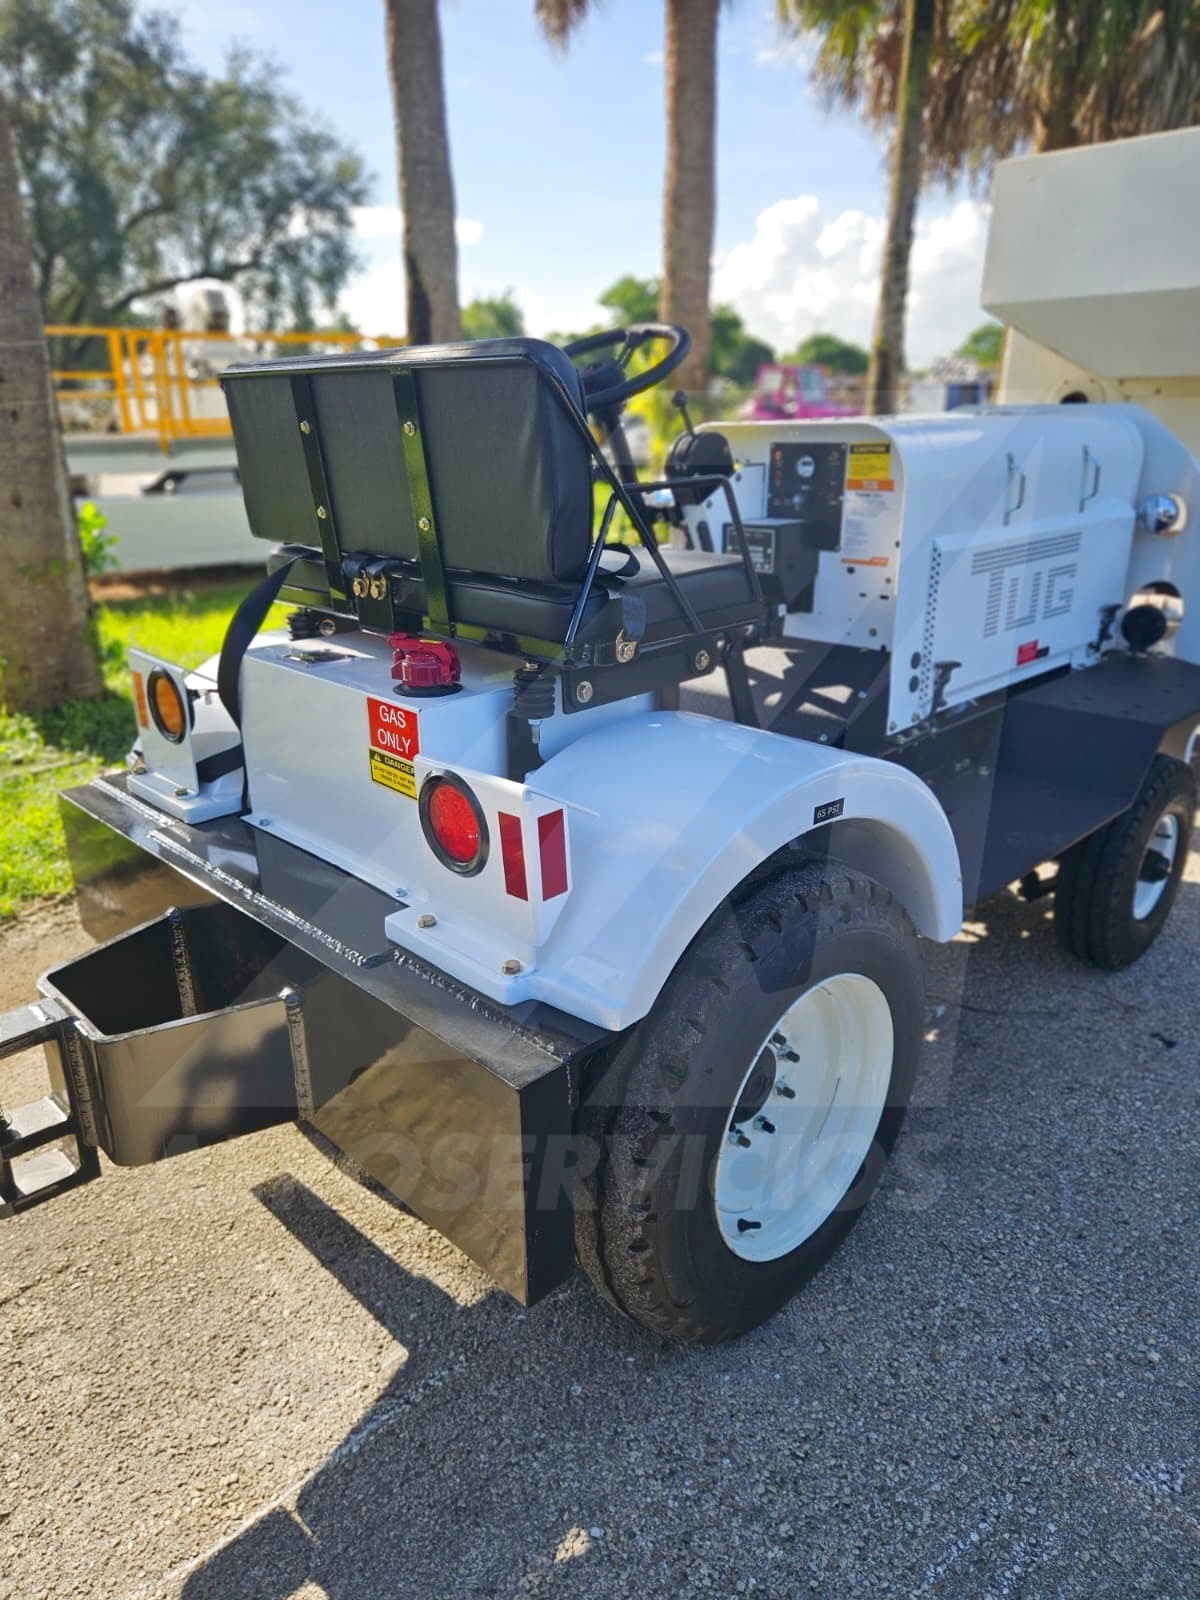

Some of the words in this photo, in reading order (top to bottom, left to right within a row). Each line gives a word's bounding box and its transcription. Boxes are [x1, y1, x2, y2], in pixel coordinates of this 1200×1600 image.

[971, 531, 1082, 638] TUG
[379, 705, 406, 728] GAS
[377, 728, 411, 754] ONLY
[816, 808, 827, 818] 65
[828, 803, 840, 815] PSI
